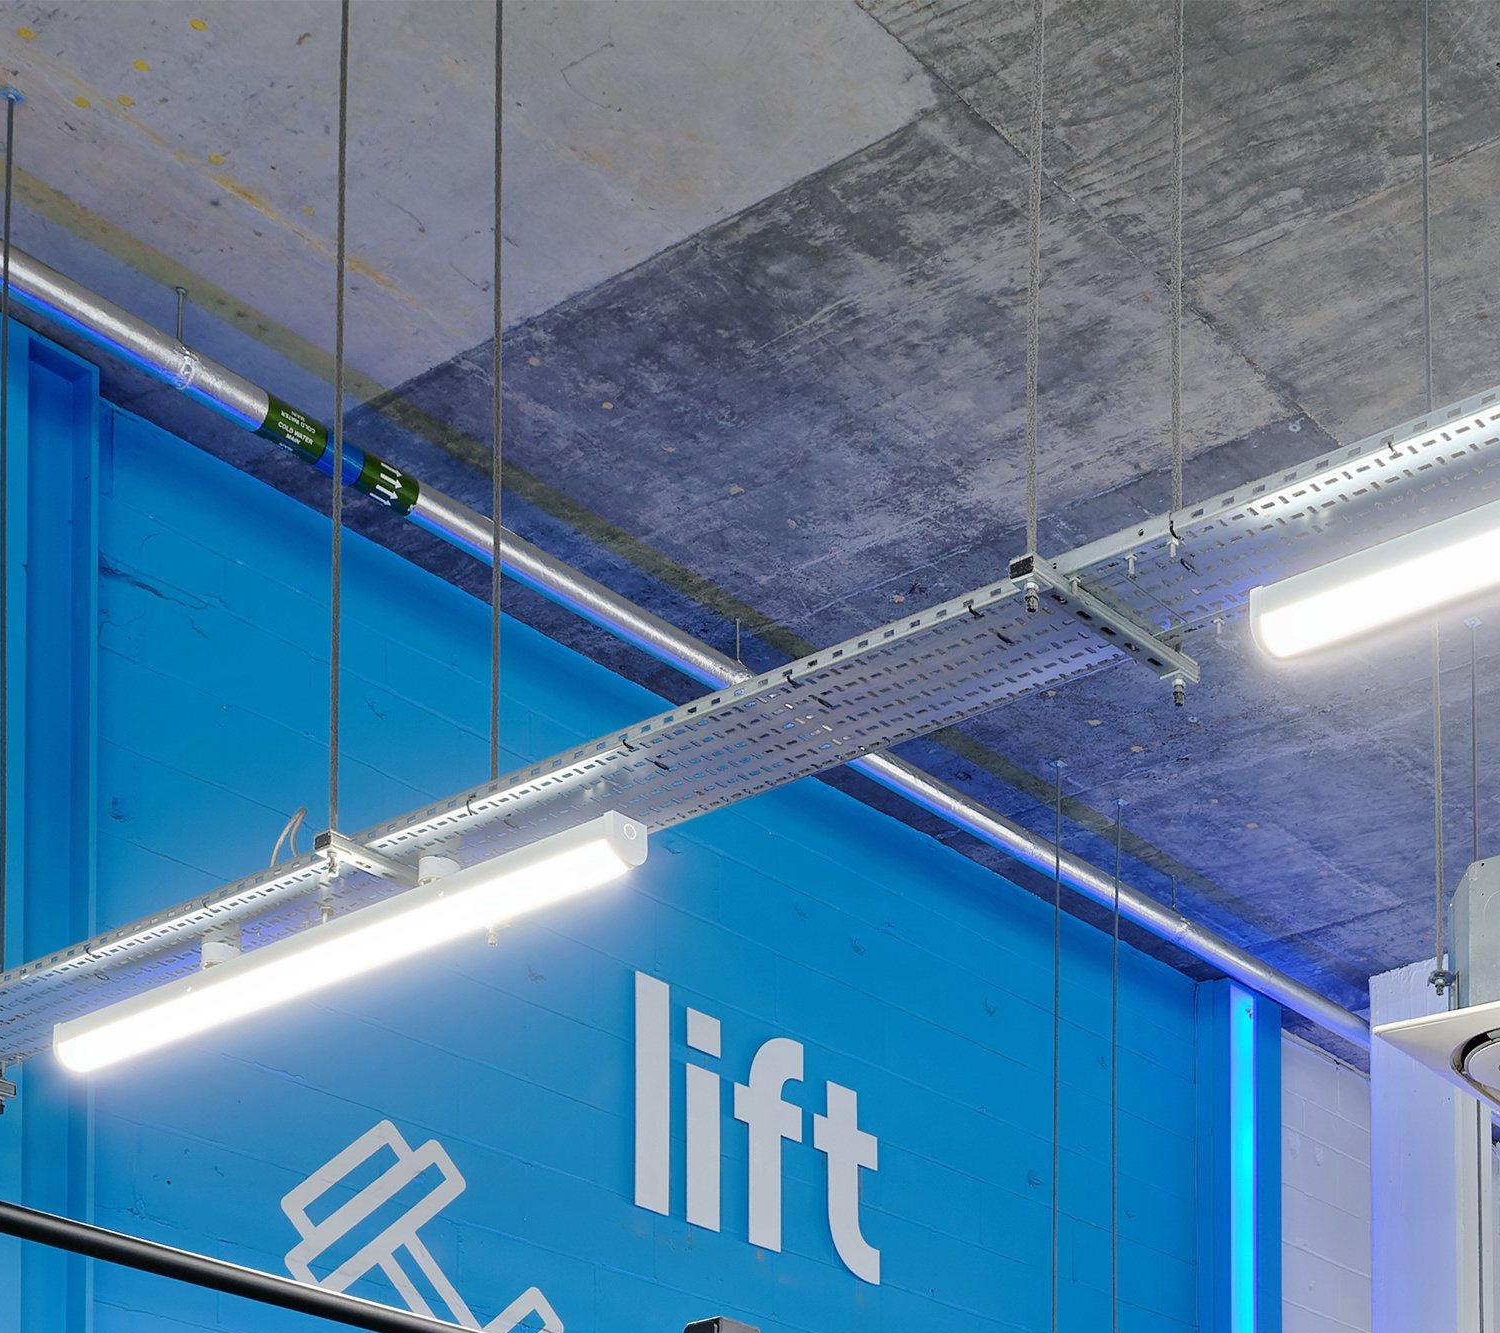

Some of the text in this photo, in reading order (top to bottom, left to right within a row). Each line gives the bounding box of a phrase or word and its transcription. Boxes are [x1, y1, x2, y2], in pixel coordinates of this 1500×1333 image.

[278, 422, 314, 445] COLD WATER
[634, 970, 880, 1285] lift
